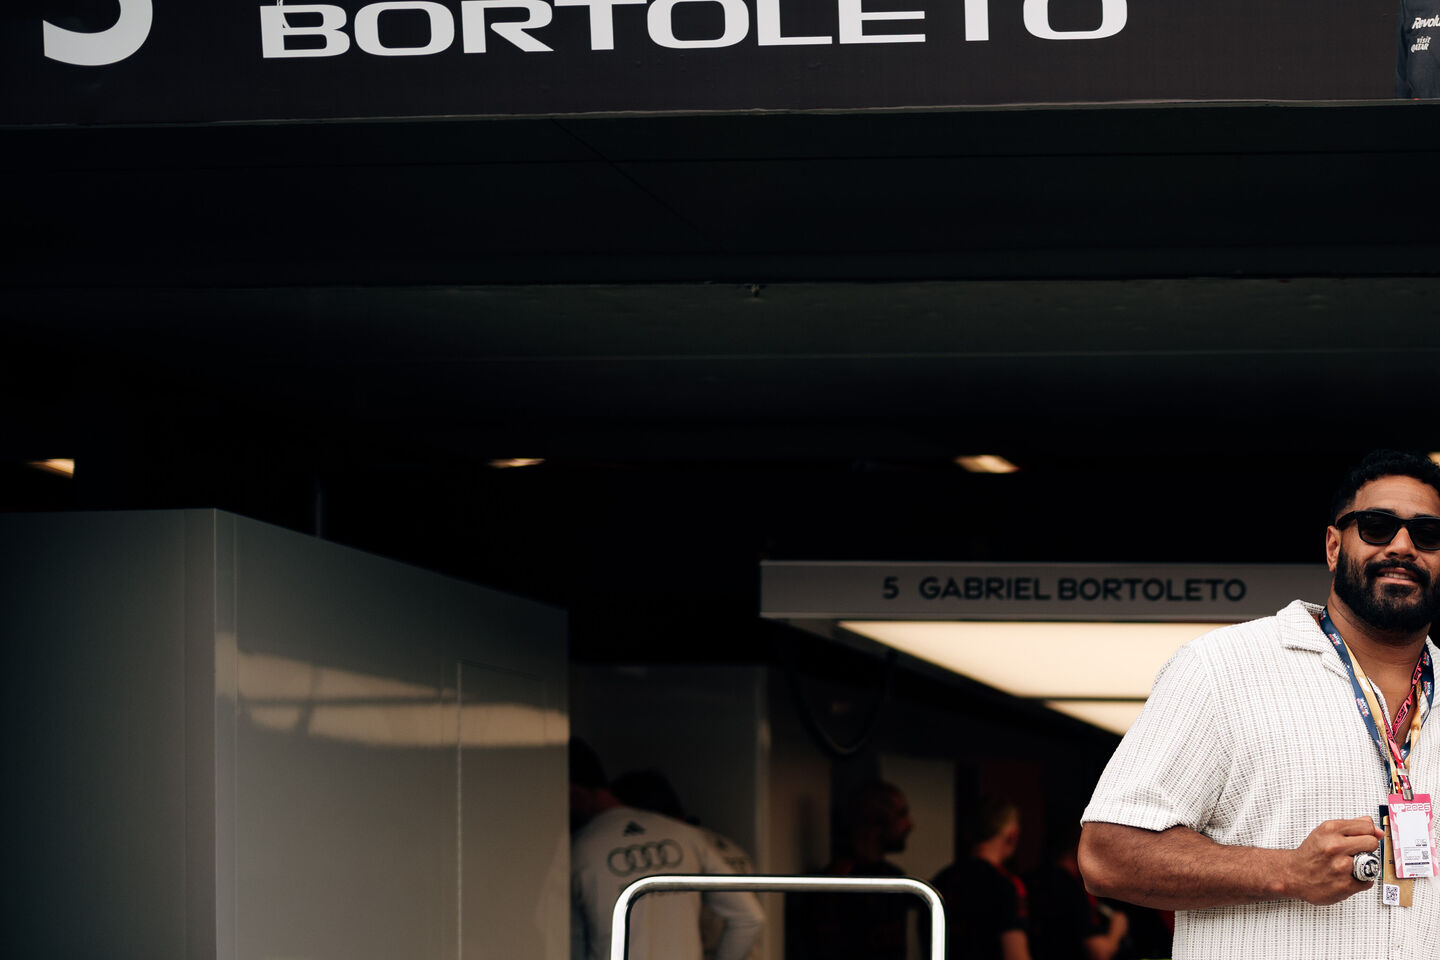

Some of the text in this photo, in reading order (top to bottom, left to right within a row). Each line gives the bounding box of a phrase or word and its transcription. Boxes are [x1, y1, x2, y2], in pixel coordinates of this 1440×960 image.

[260, 0, 1128, 58] BORTOLETO
[883, 576, 1247, 602] 5 GABRIEL BORTOLETO
